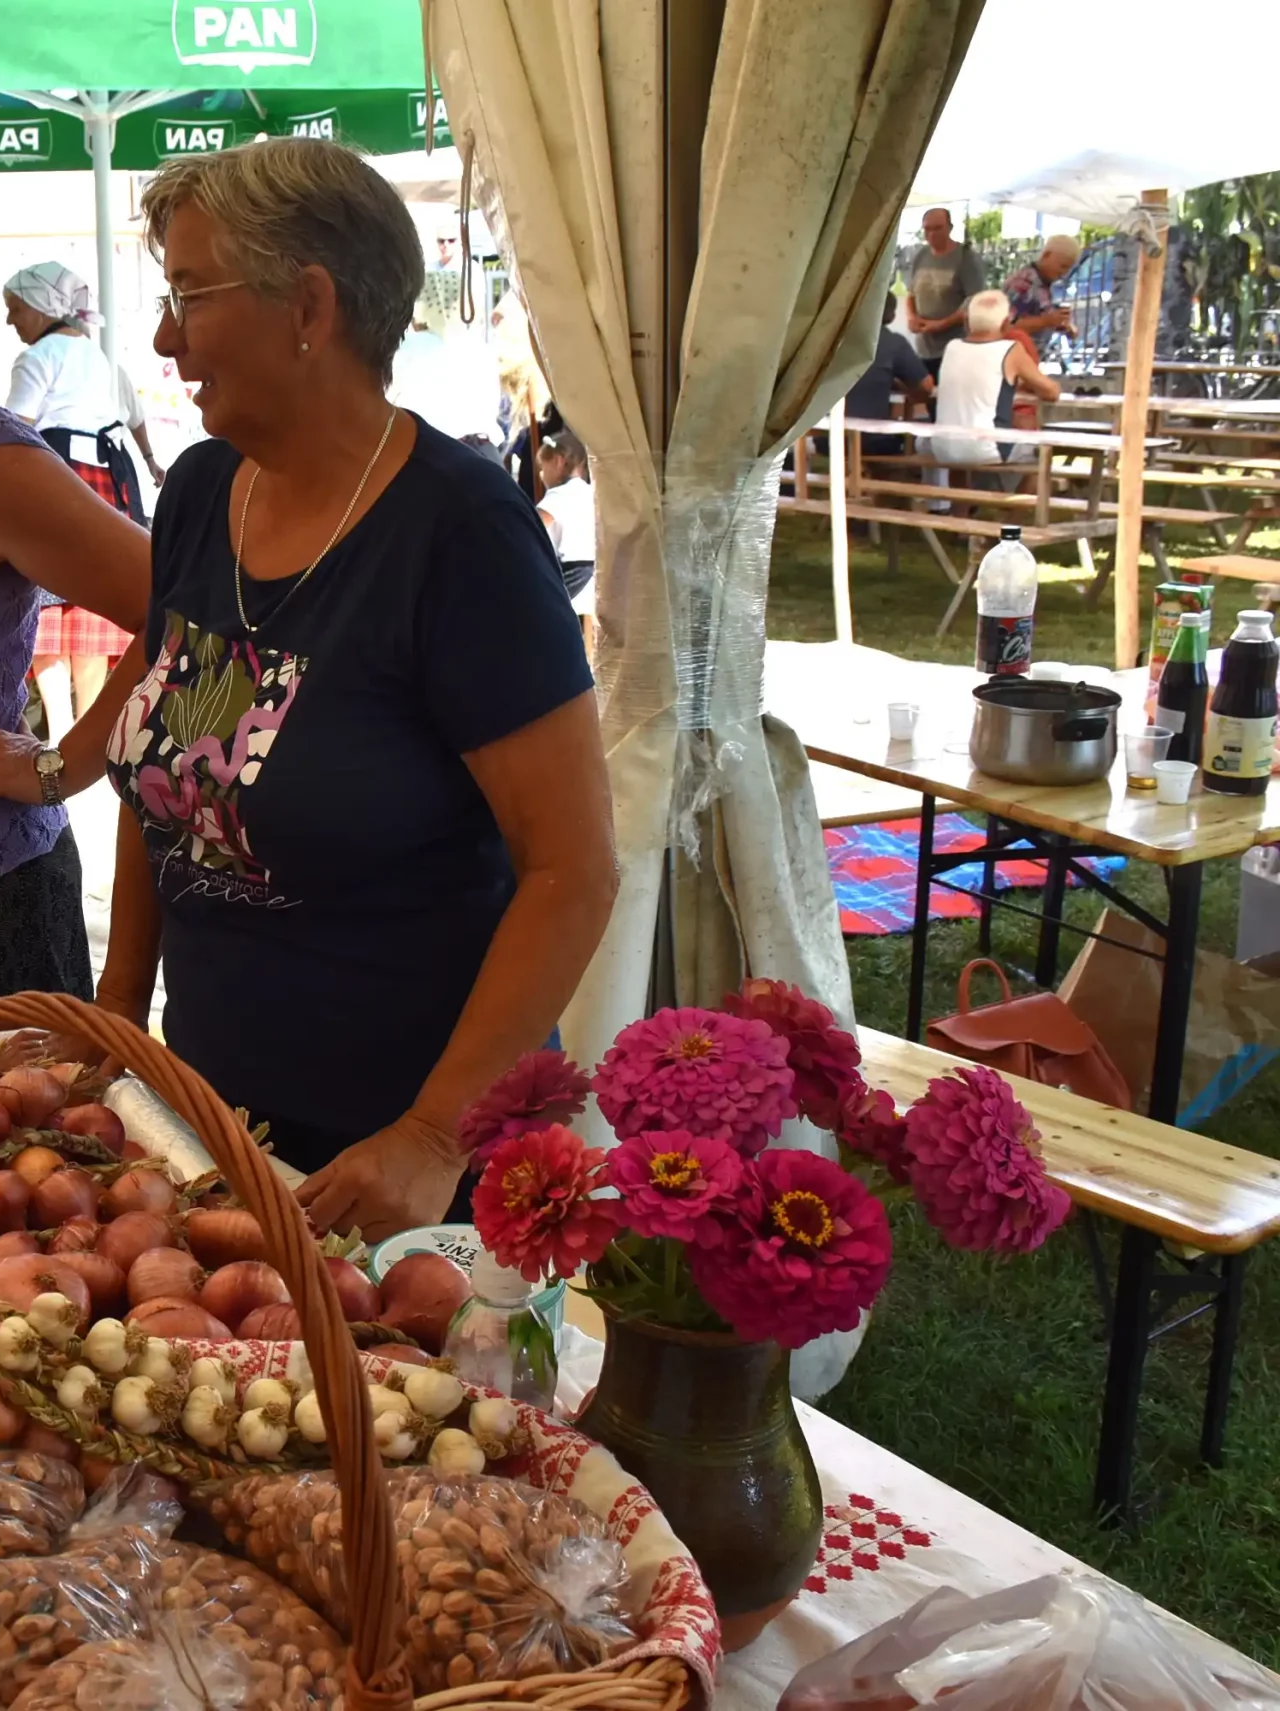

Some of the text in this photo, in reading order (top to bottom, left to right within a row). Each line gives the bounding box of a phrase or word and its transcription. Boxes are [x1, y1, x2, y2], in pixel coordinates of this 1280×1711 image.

[193, 7, 298, 48] PAN
[187, 866, 205, 881] the
[209, 872, 269, 898] abstract
